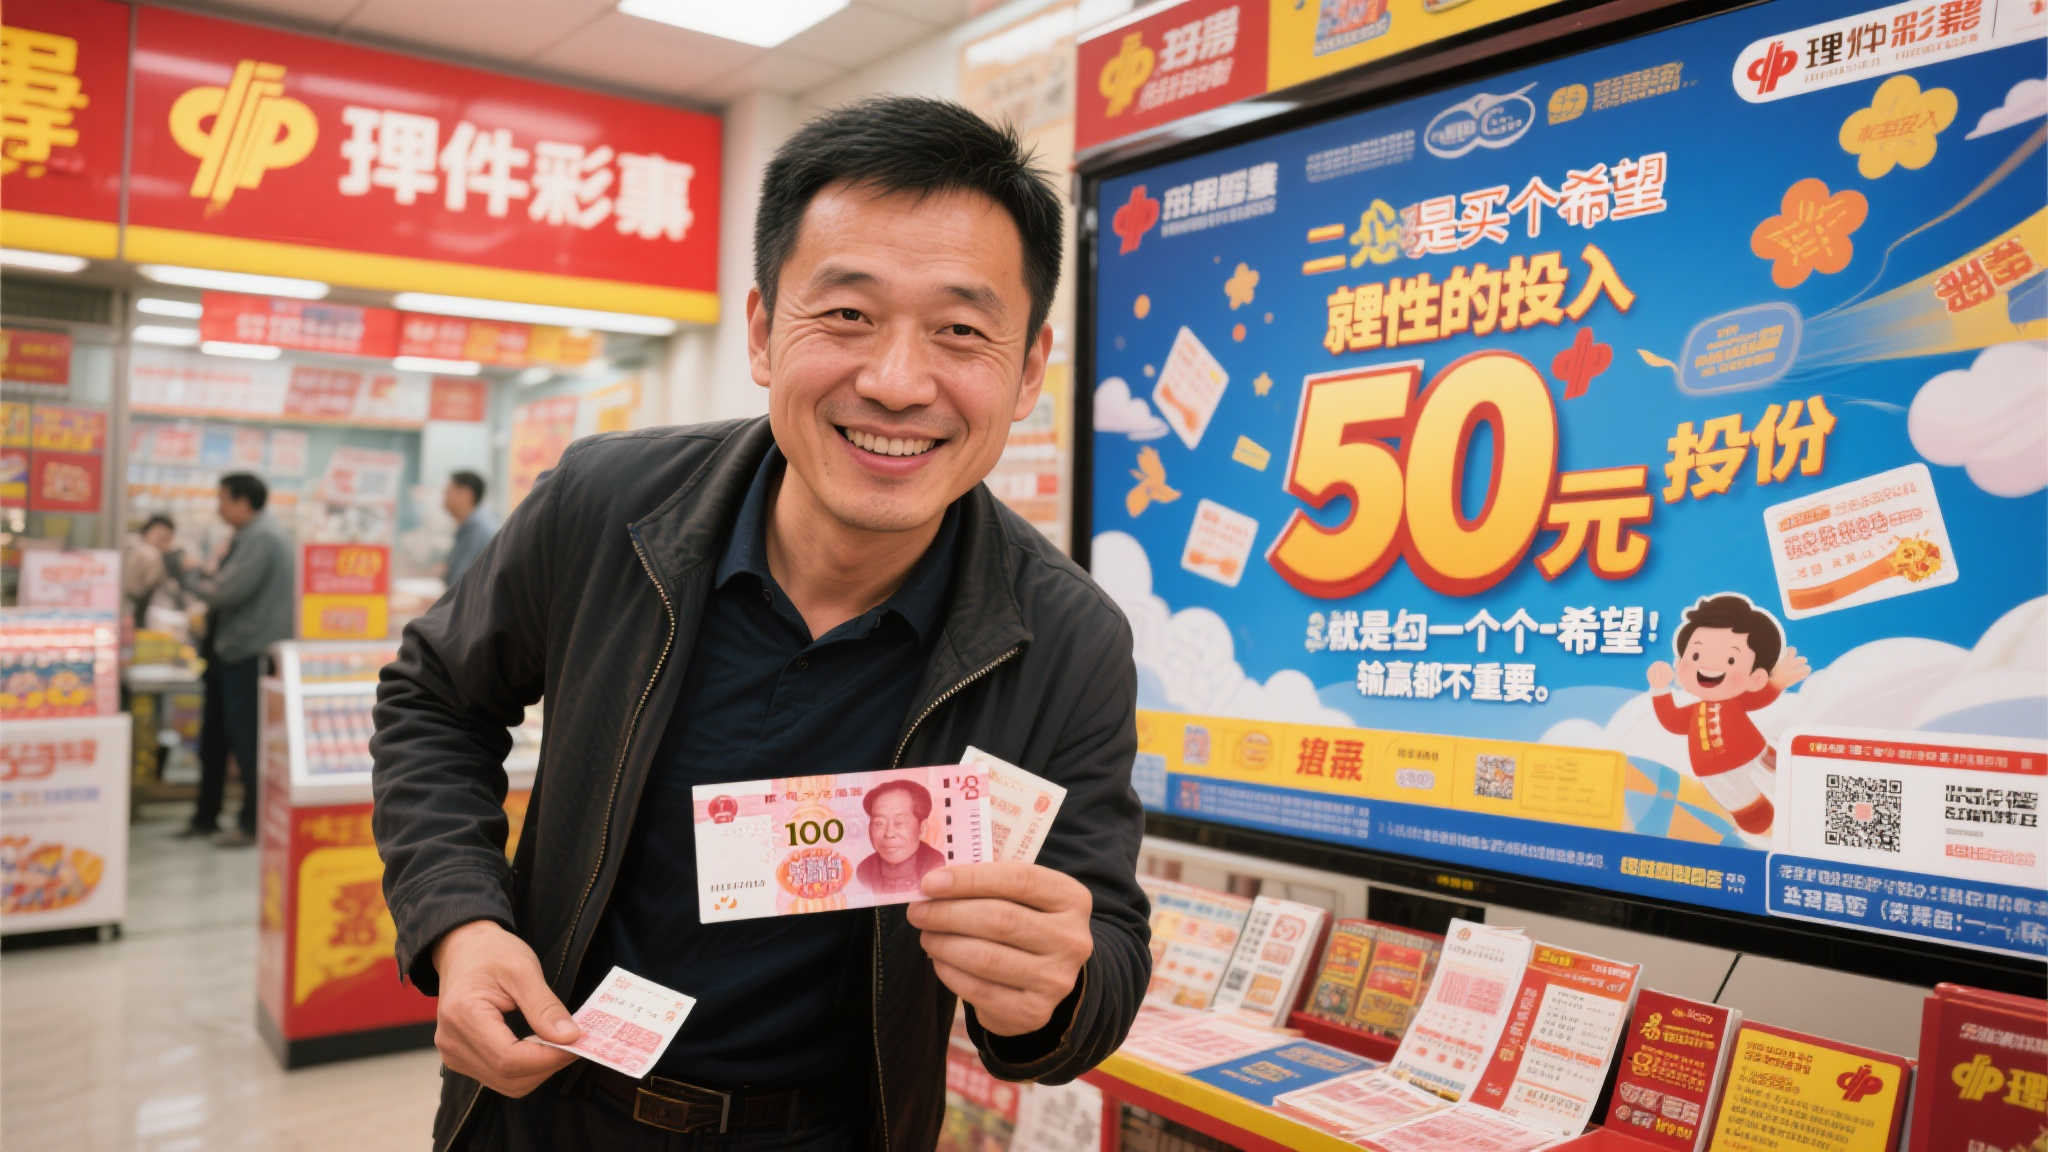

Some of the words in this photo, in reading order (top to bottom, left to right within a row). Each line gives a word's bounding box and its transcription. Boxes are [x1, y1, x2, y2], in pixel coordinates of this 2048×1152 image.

[1356, 660, 1550, 703] 输赢都不重要。
[784, 818, 844, 847] 100
